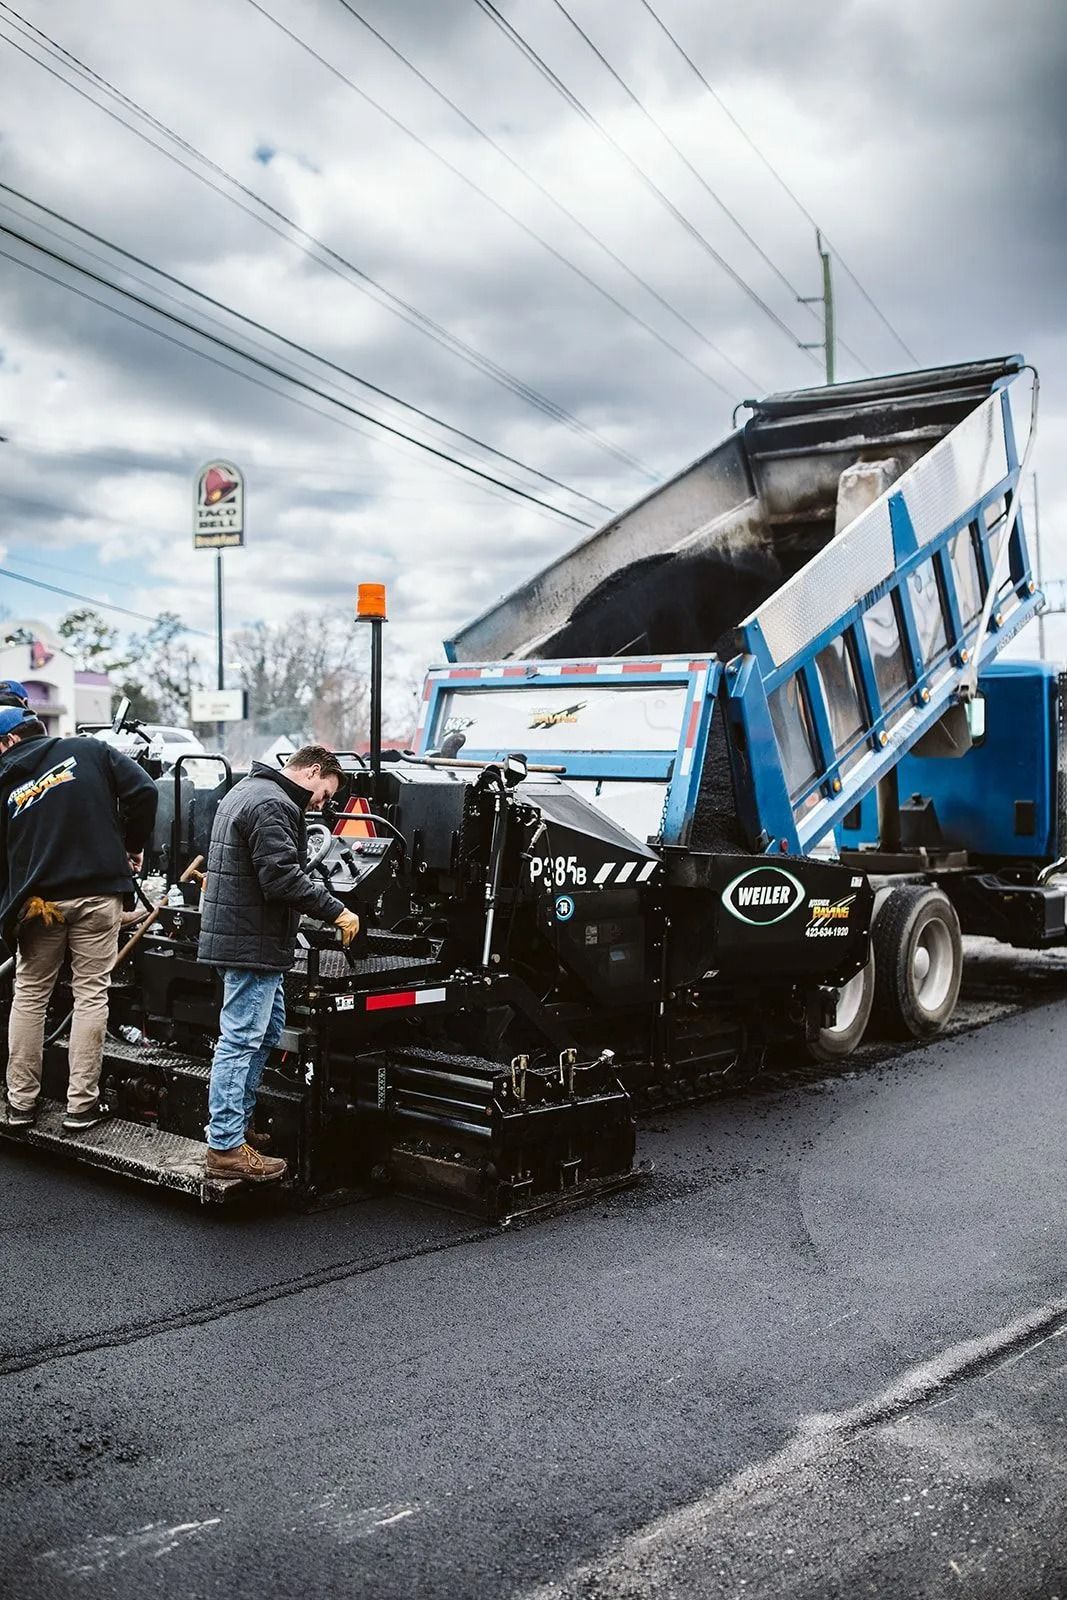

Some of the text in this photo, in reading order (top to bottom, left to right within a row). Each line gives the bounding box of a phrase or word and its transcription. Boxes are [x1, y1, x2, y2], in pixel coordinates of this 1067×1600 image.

[198, 508, 236, 517] TACO
[199, 520, 235, 528] BELL
[738, 885, 791, 907] WEILER
[812, 906, 850, 919] PAVING
[805, 926, 849, 938] 423-634-1920
